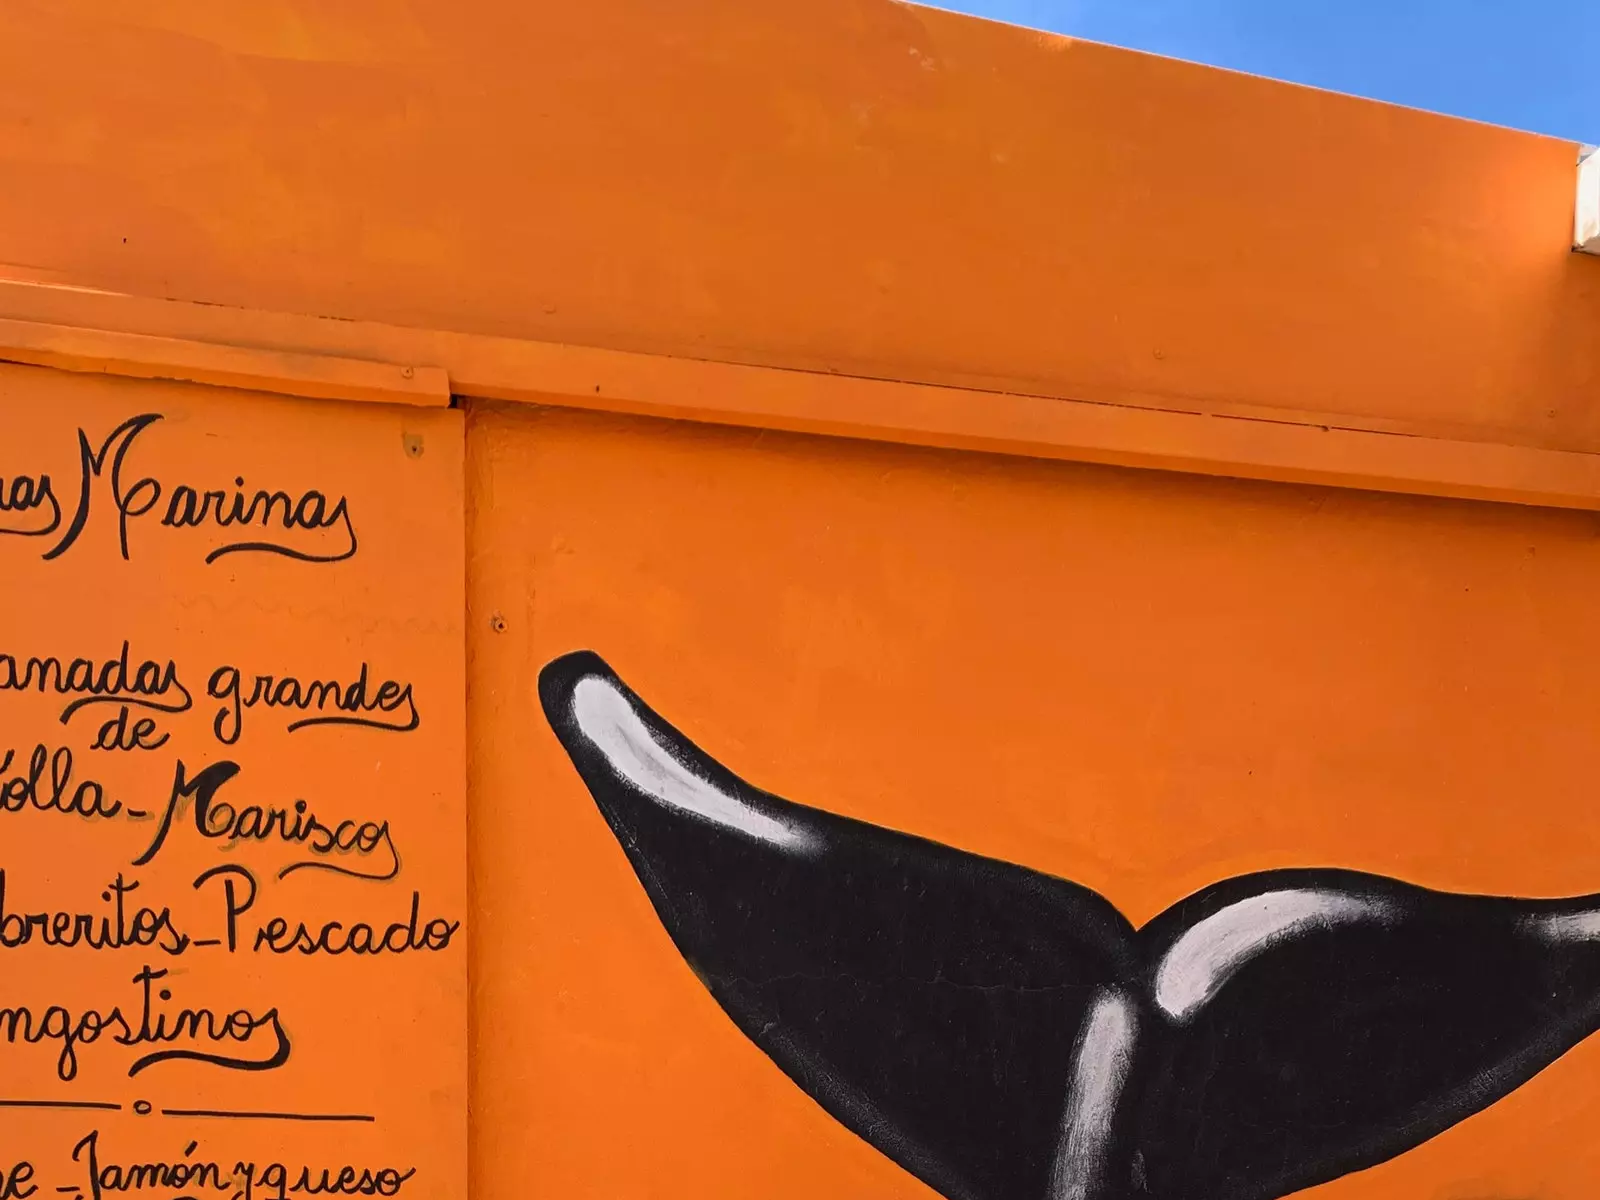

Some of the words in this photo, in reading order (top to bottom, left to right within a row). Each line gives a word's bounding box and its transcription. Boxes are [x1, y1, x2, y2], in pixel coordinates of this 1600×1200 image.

[0, 474, 62, 537] as
[42, 413, 358, 564] Marinas
[90, 705, 171, 751] de
[207, 662, 420, 745] grandes
[132, 759, 399, 881] Mariscos
[193, 863, 459, 955] Pescado
